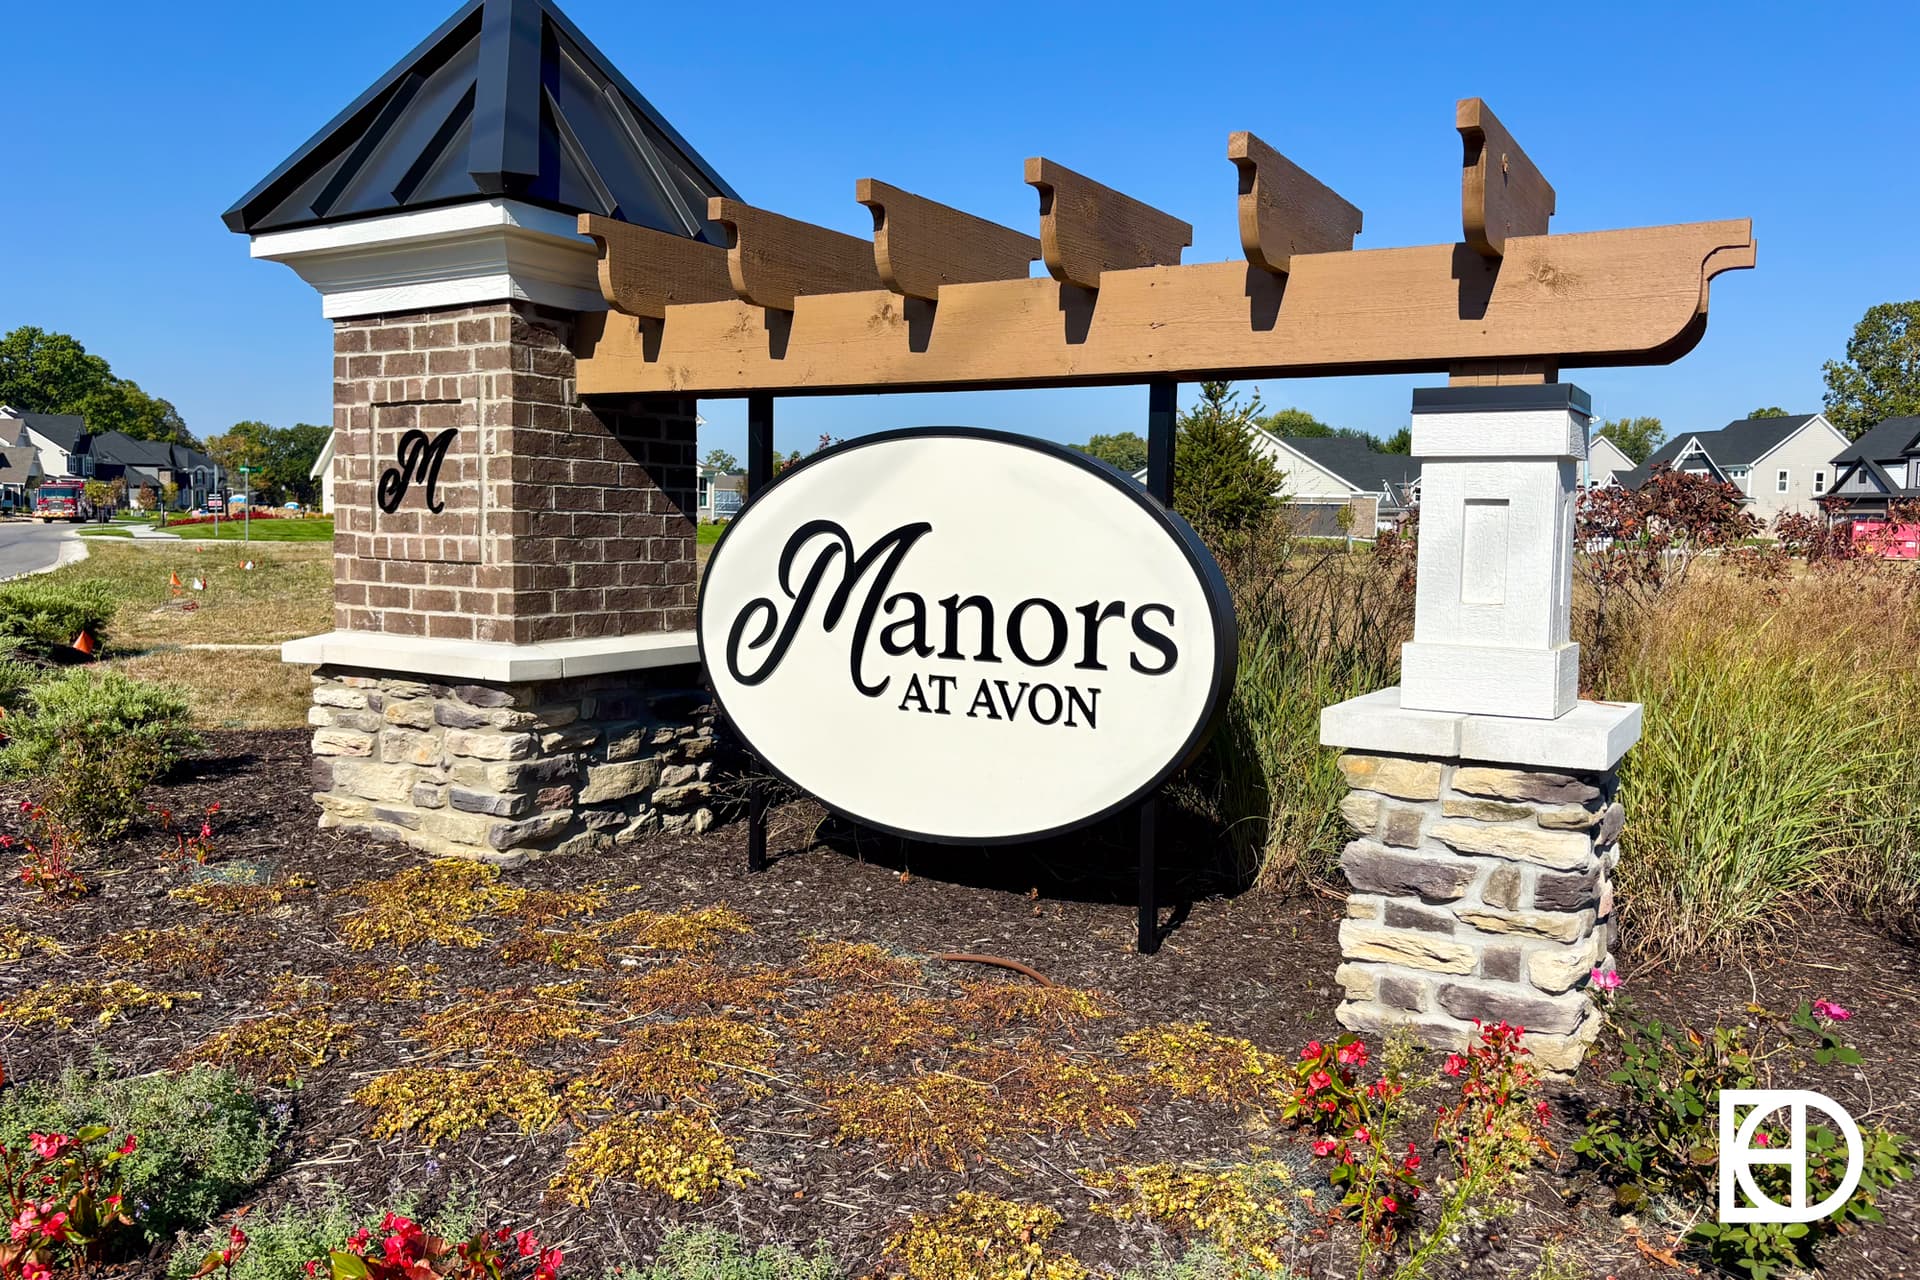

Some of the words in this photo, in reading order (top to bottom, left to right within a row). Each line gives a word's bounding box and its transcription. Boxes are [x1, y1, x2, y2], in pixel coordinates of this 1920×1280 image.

[377, 428, 459, 514] M
[726, 519, 1179, 698] Manors
[898, 673, 958, 715] AT
[966, 678, 1102, 730] AVON
